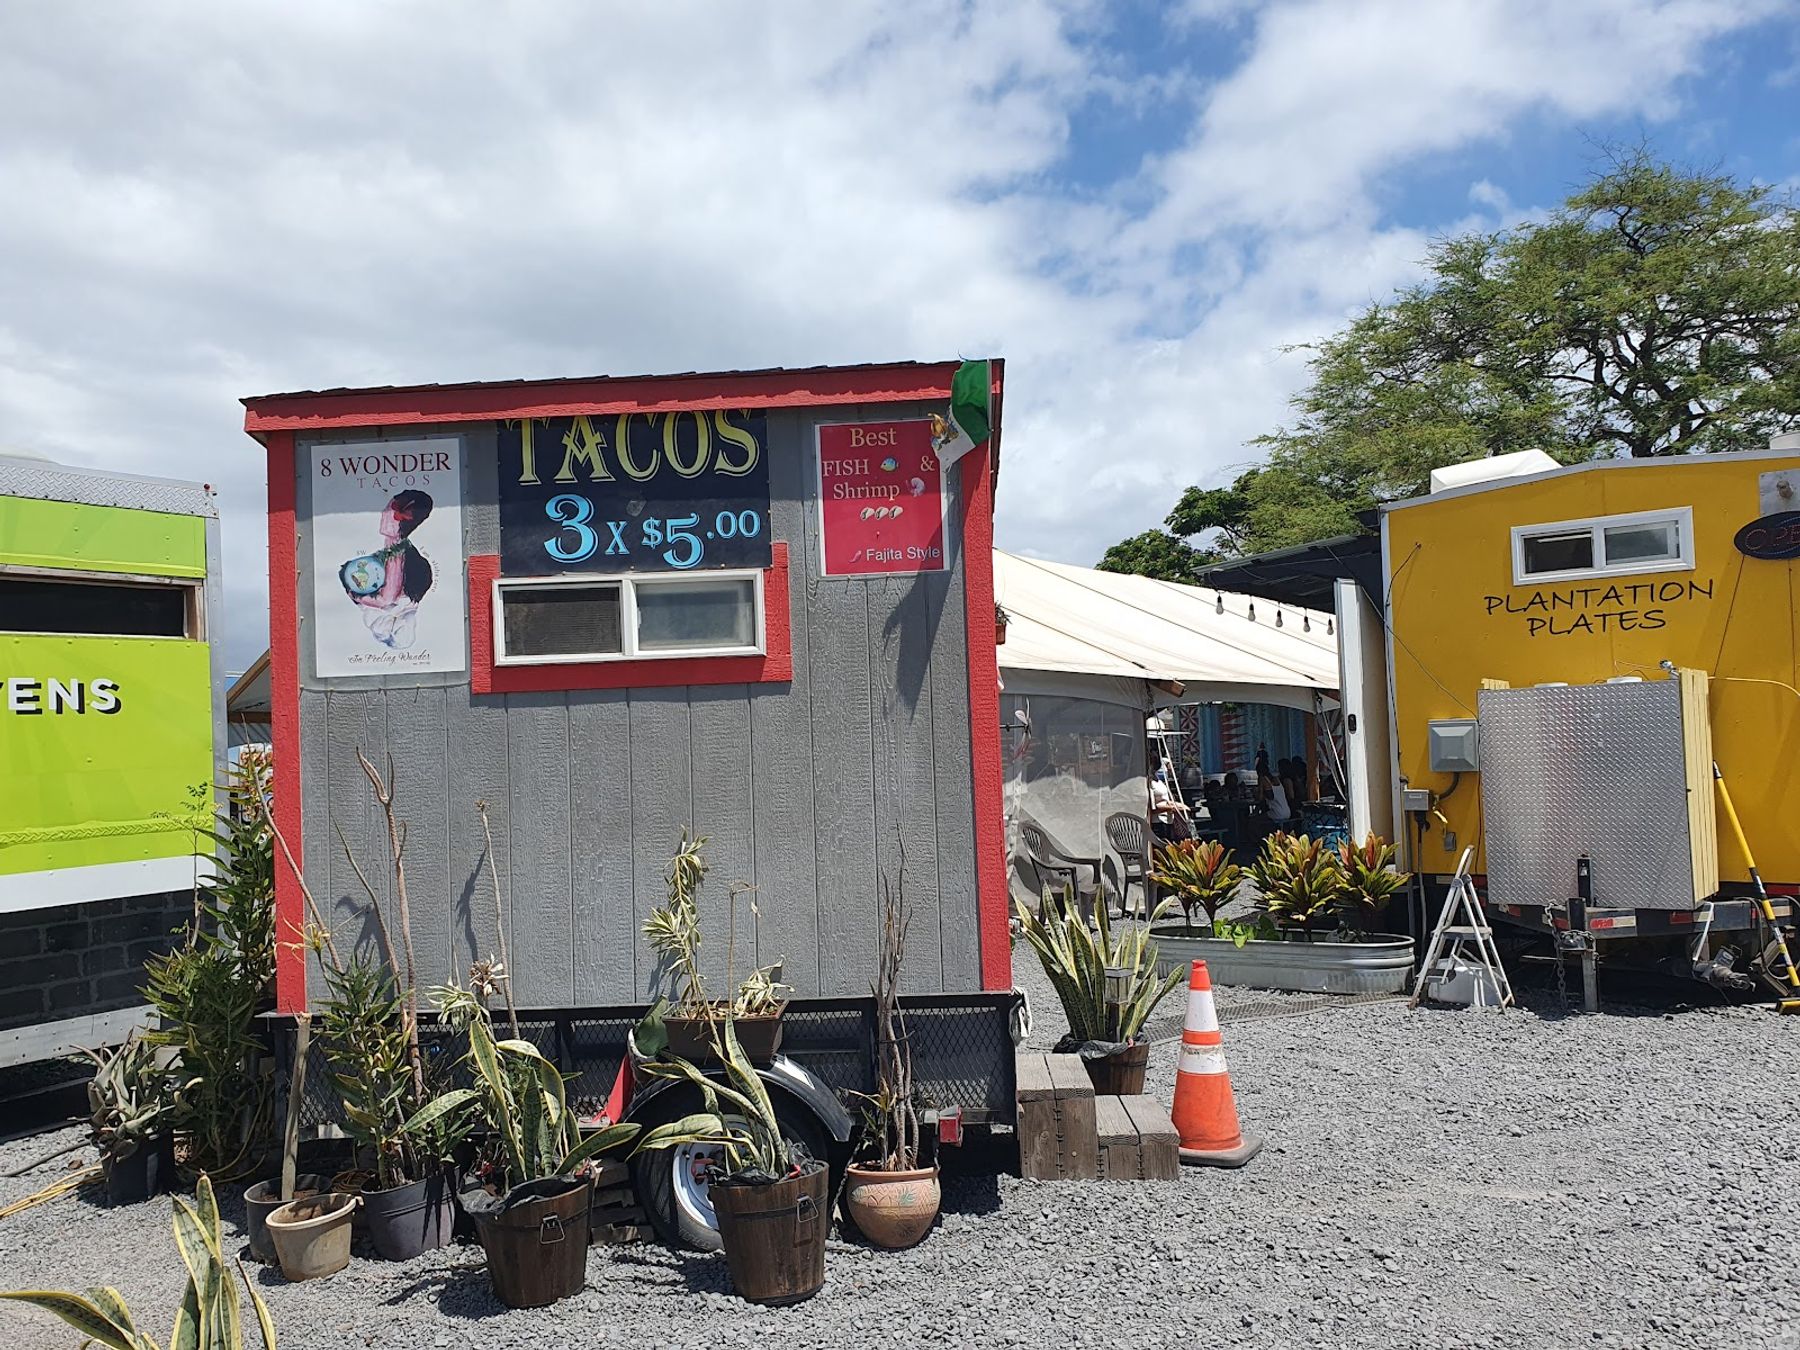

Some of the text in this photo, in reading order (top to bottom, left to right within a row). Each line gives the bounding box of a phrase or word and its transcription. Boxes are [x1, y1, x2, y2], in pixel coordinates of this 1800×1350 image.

[504, 409, 760, 486] TACOS
[850, 427, 897, 448] Best
[320, 452, 452, 478] 8 WONDER
[823, 455, 935, 477] FISH &
[357, 474, 430, 489] TACOS
[833, 481, 900, 501] Shrimp
[543, 493, 598, 564] 3
[641, 509, 761, 569] $5.00
[866, 545, 941, 564] Fajita Style
[1484, 578, 1714, 615] PLANTATION
[1526, 609, 1667, 637] PLATES
[0, 677, 122, 715] ENS
